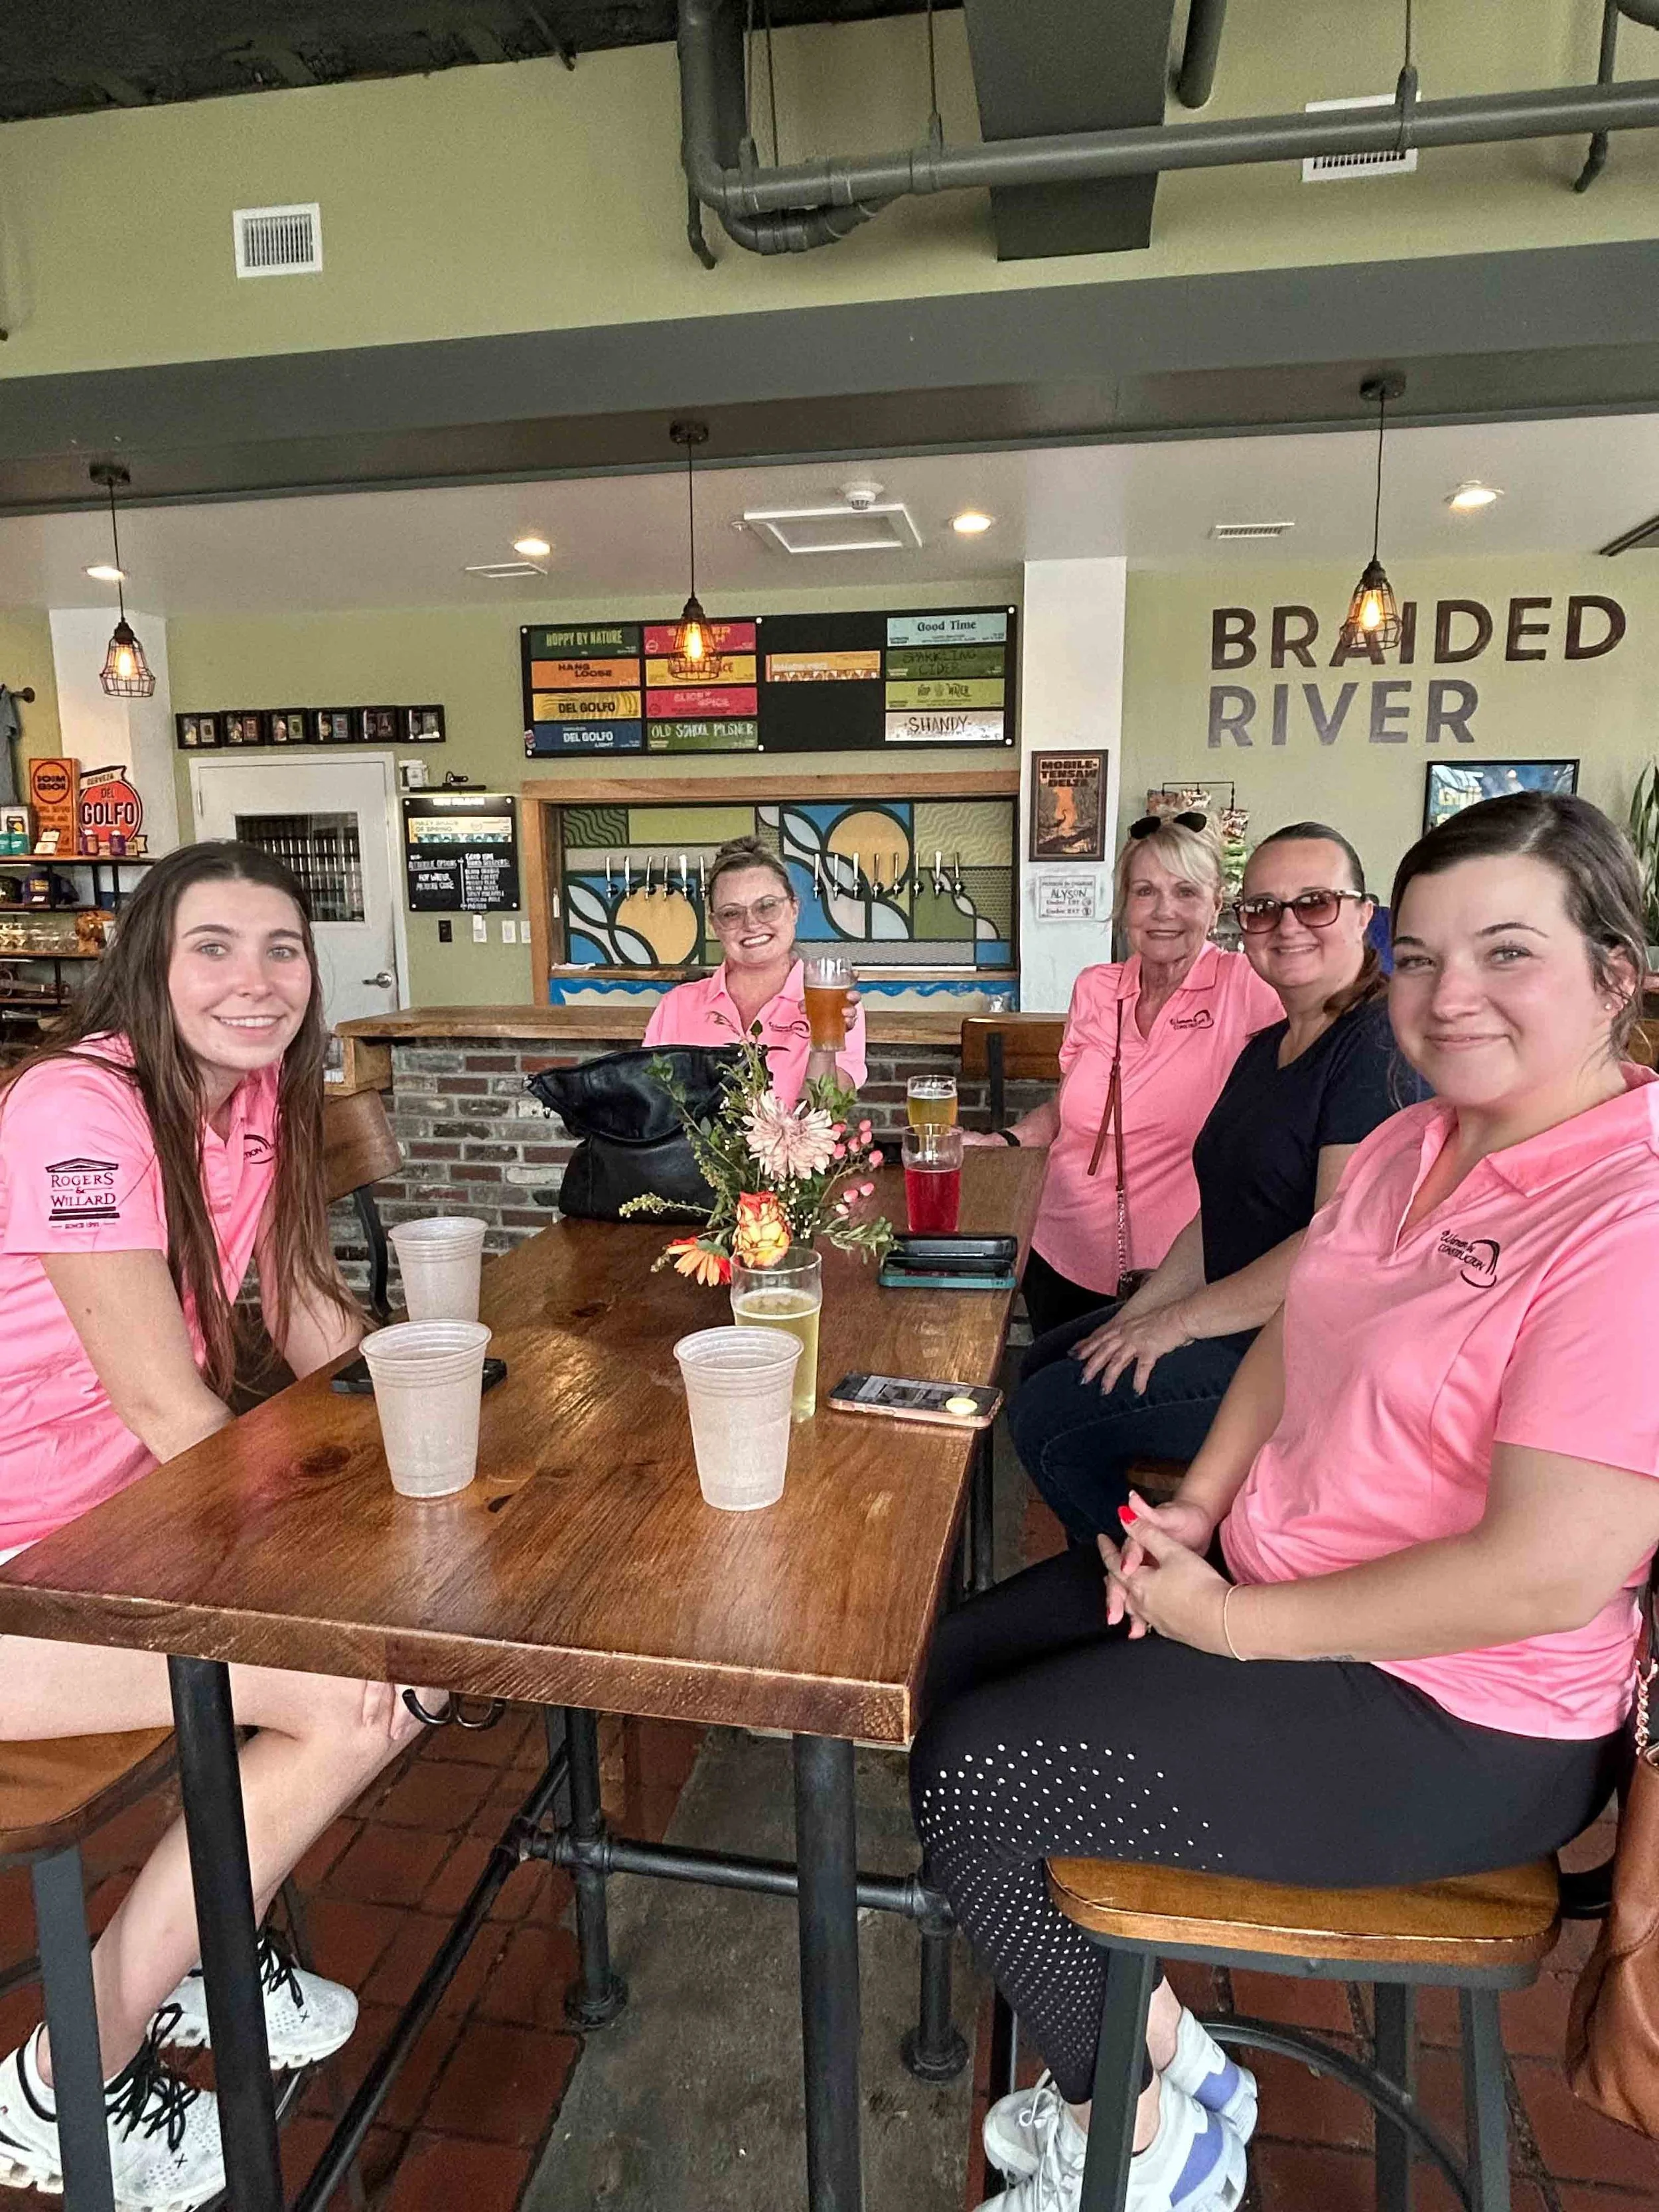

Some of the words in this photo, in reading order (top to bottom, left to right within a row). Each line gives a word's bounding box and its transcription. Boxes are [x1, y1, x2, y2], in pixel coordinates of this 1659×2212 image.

[917, 621, 945, 632] Good
[950, 619, 977, 630] Time
[1212, 595, 1626, 670] BRAIDED
[546, 632, 575, 648] HOPPY
[577, 631, 588, 646] BY
[590, 628, 623, 644] NATURE
[918, 662, 960, 676] CIDER
[558, 703, 577, 713] DEL
[580, 701, 616, 712] GOLFO
[1208, 678, 1479, 749] RIVER
[651, 724, 672, 739] OLD
[713, 722, 755, 737] PILSNER
[908, 714, 969, 734] SHANDY
[563, 732, 581, 743] DEL
[581, 731, 614, 742] GOLFO
[87, 773, 114, 786] CERVEZA
[1040, 769, 1098, 778] TENSAW
[1048, 778, 1089, 787] DELTA
[100, 787, 115, 799] DEL
[82, 802, 135, 826] GOLFO
[1050, 888, 1088, 901] ALYSON
[51, 1171, 114, 1188] ROGERS
[50, 1193, 116, 1207] WILLARD
